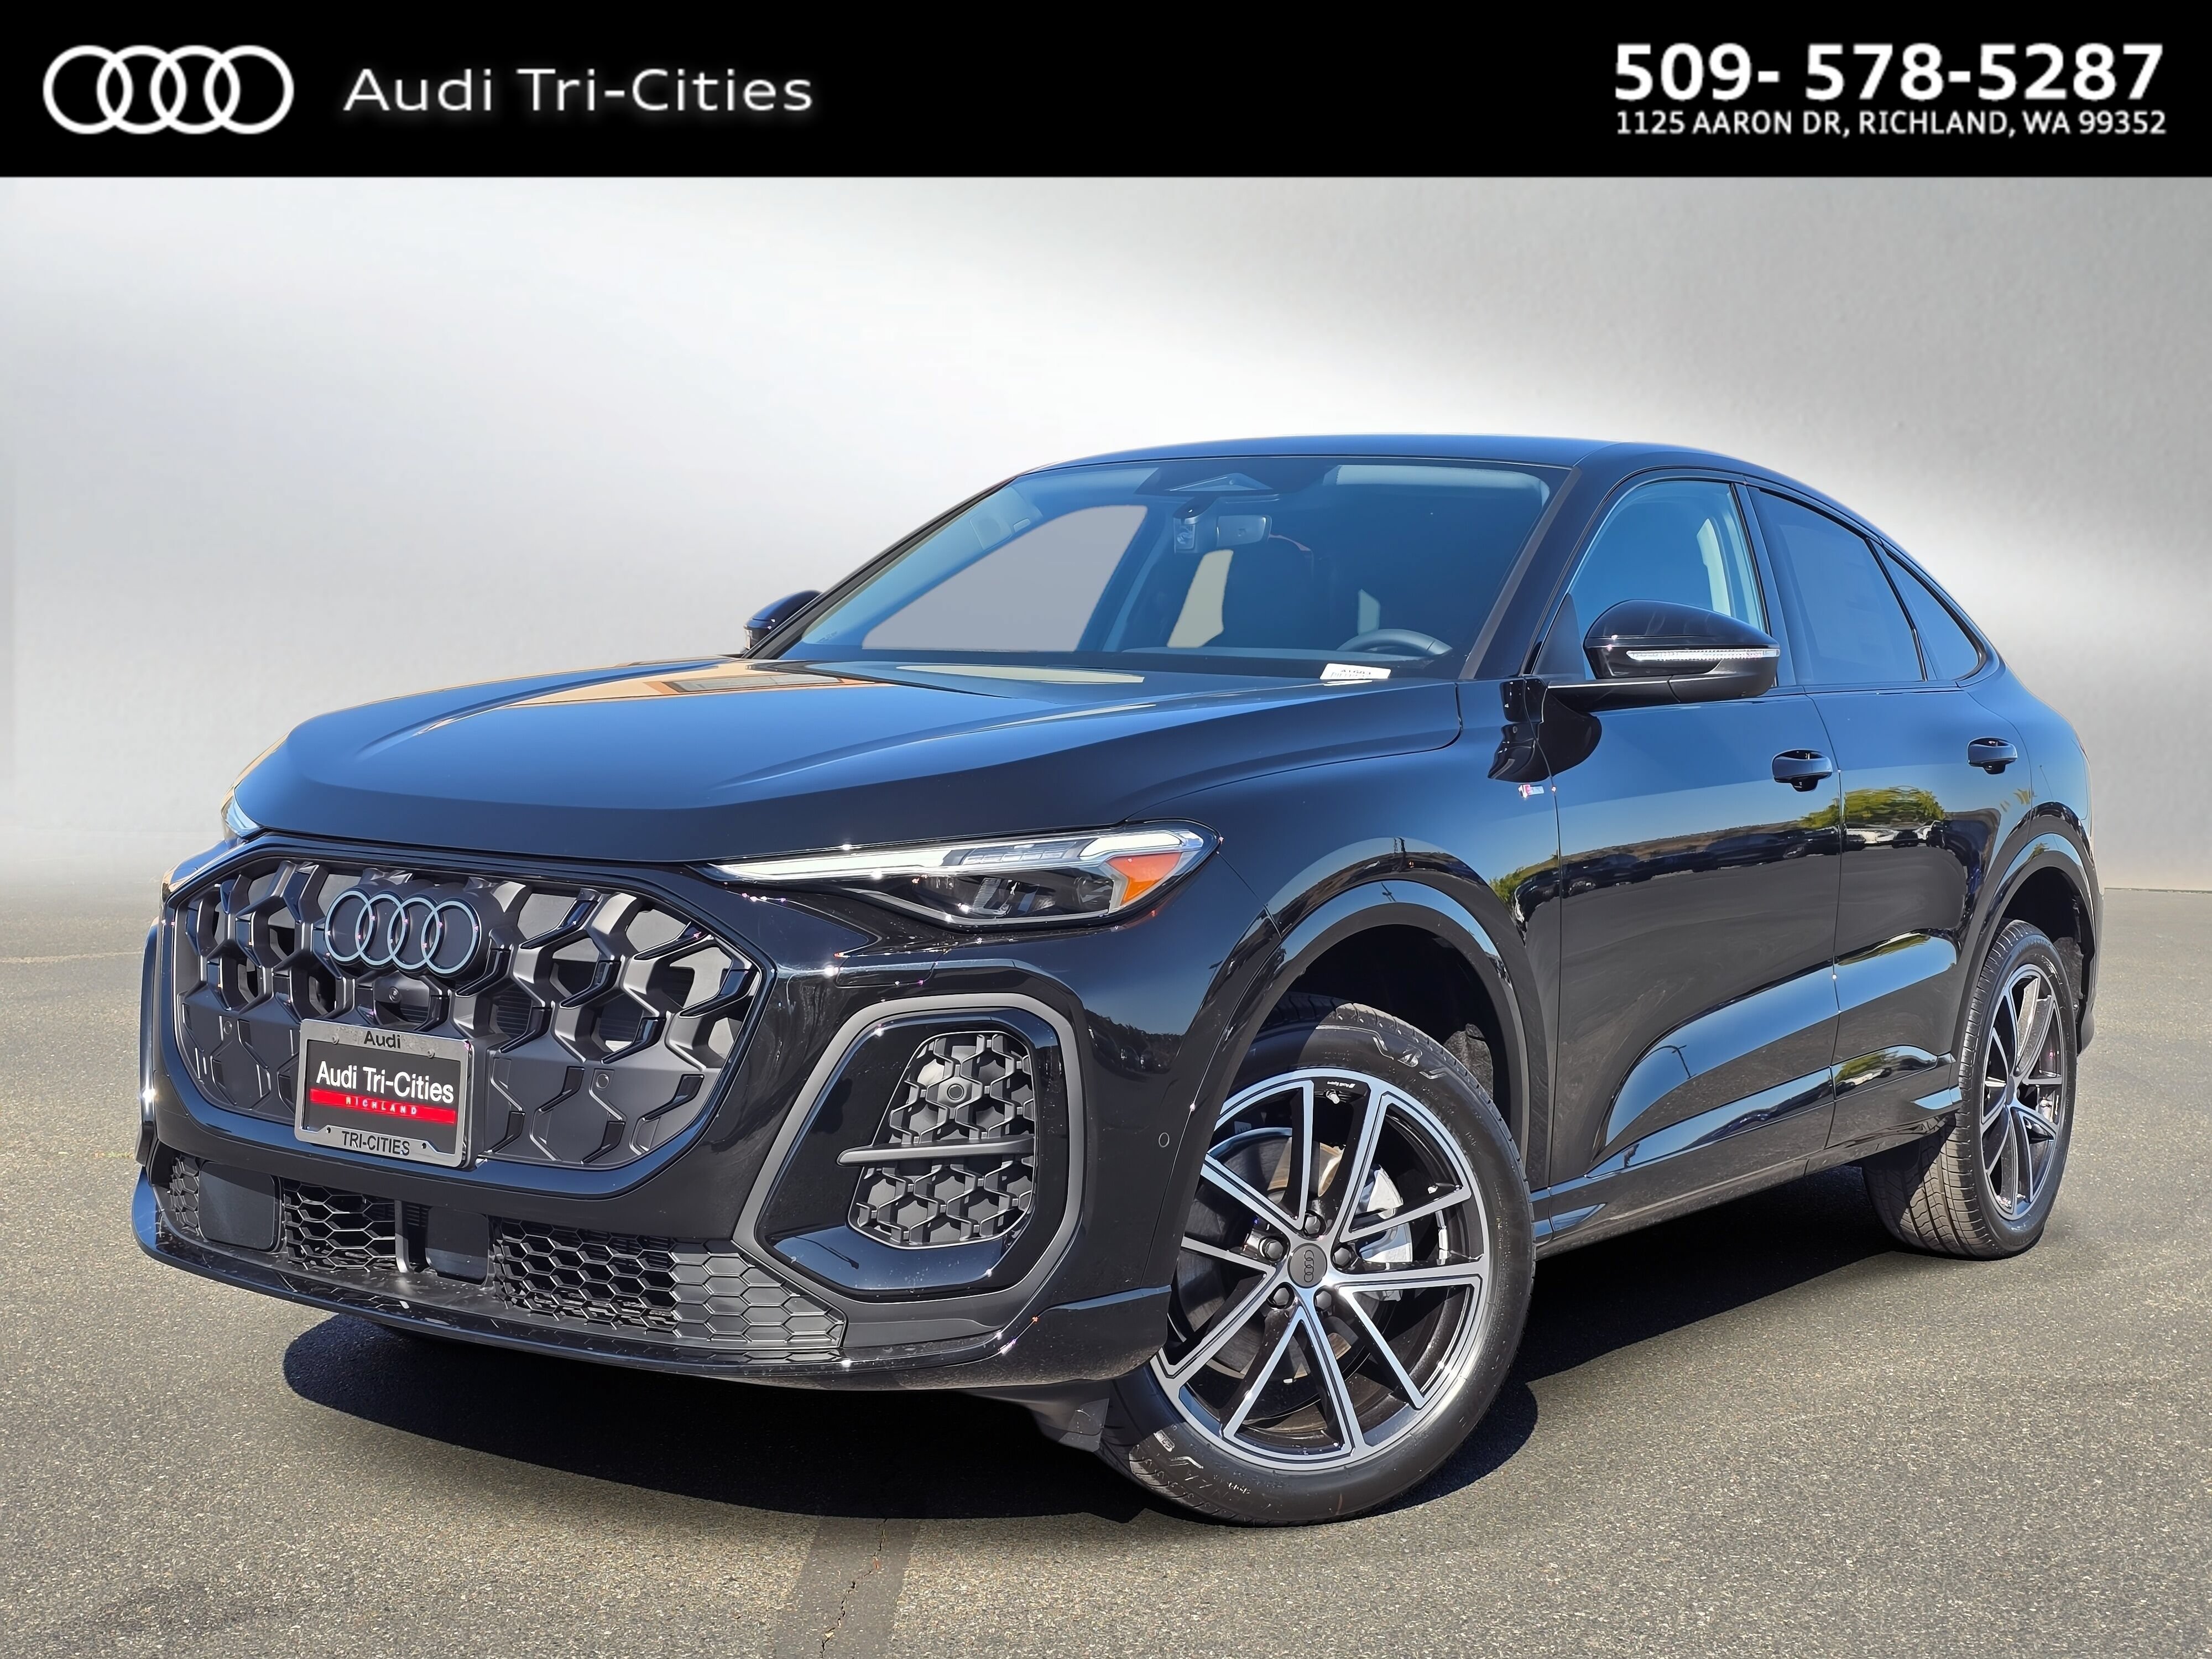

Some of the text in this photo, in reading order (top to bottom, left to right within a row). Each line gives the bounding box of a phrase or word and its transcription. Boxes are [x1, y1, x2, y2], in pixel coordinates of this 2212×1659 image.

[363, 1030, 401, 1049] Audi
[316, 1060, 455, 1104] Audi Tri-Cities
[345, 1096, 418, 1115] RICHLAND
[341, 1130, 410, 1156] TRI-CITIES
